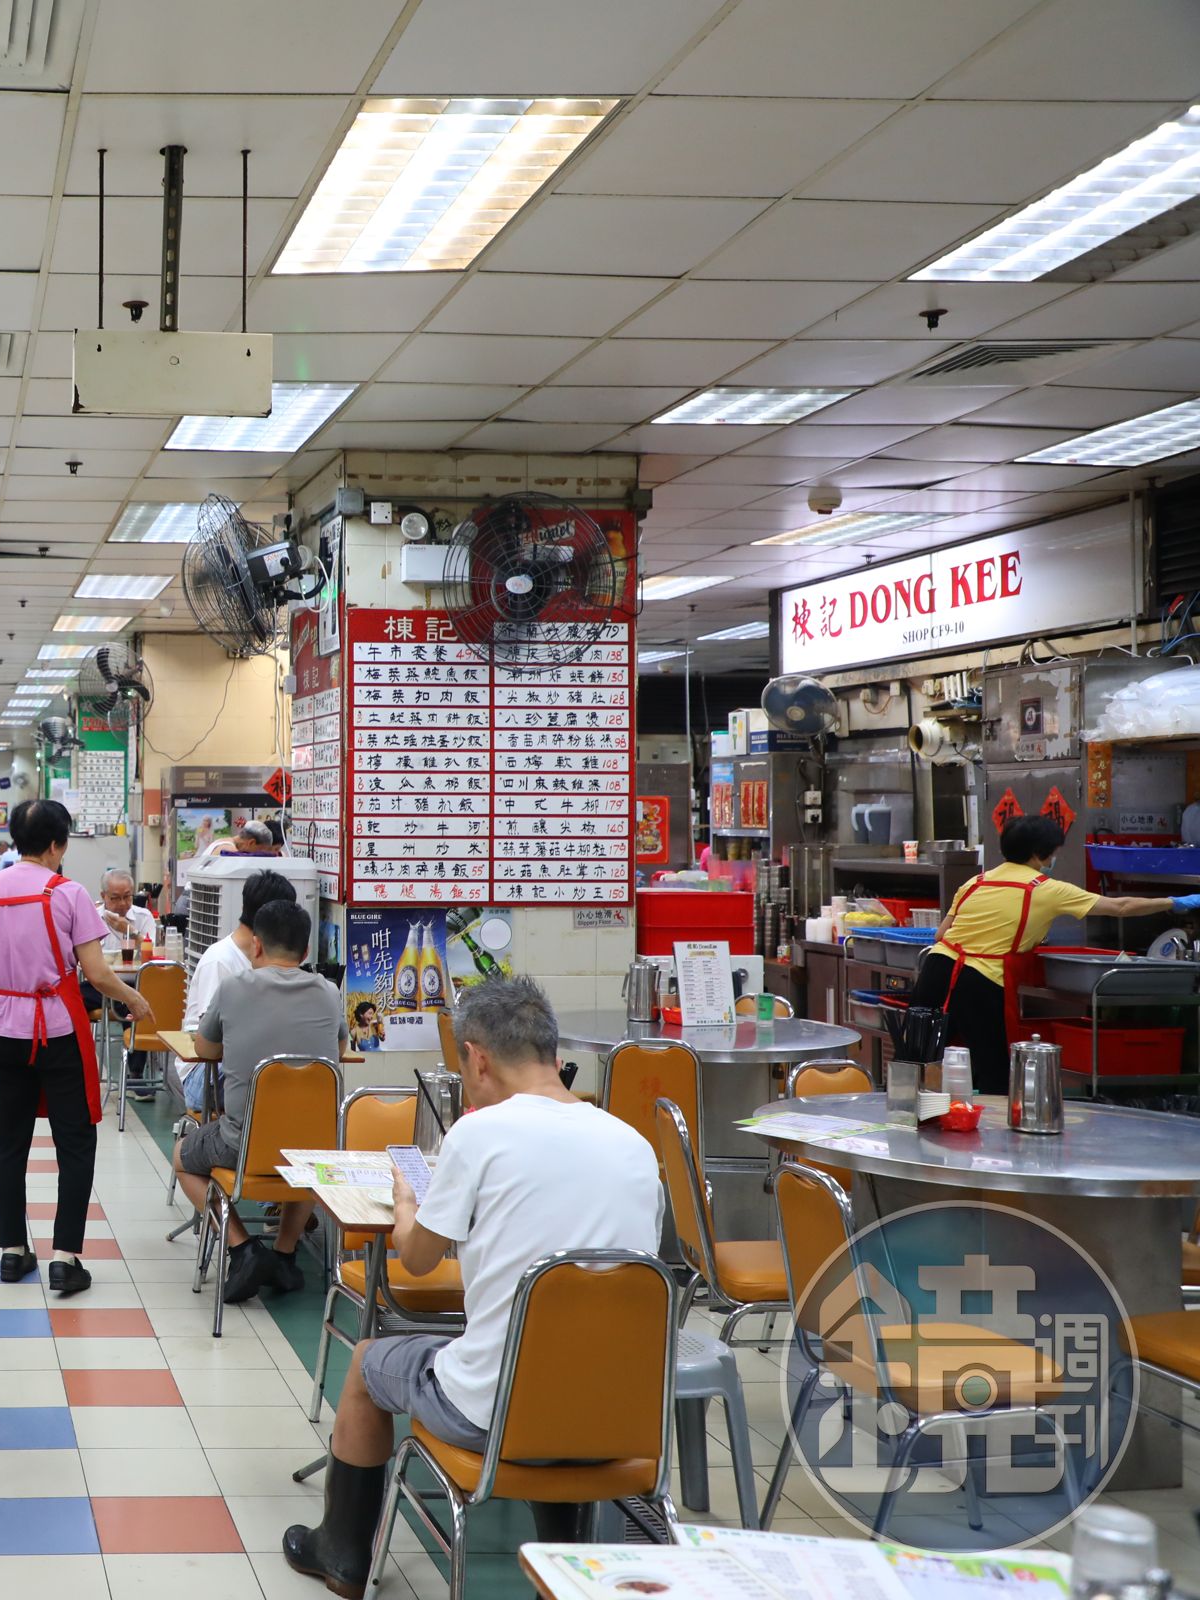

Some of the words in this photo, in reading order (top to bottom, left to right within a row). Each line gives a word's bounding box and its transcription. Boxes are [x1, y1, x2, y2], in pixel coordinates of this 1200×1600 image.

[791, 595, 843, 646] 棟記
[849, 572, 936, 629] DONG
[950, 550, 1023, 608] KEE
[383, 615, 458, 641] 棟記
[902, 628, 930, 645] SHOP
[930, 621, 965, 640] CF9-10
[367, 644, 449, 662] 午市套餐
[606, 650, 623, 661] 138
[607, 672, 623, 683] 130
[364, 689, 481, 704] 梅菜扣肉飯
[507, 690, 605, 704] 尖椒炒豬肚
[609, 694, 625, 704] 128
[605, 715, 623, 725] 128
[615, 738, 627, 748] 98
[602, 759, 618, 769] 108
[605, 781, 621, 791] 108
[504, 797, 600, 813] 中式牛柳
[605, 800, 623, 811] 179
[1120, 815, 1154, 824] 小心地滑
[367, 819, 481, 836] 乾炒牛河
[506, 819, 597, 836] 煎釀尖椒
[607, 823, 624, 833] 140
[365, 842, 482, 857] 星州炒米
[609, 844, 626, 856] 179
[472, 866, 484, 876] 55
[610, 868, 625, 878] 120
[373, 883, 468, 899] 鴨腿湯飯
[469, 890, 481, 899] 55
[506, 884, 604, 900] 棟記小炒王
[608, 891, 624, 899] 150
[576, 910, 613, 920] 小心地滑
[371, 927, 397, 1014] 咁先夠爽
